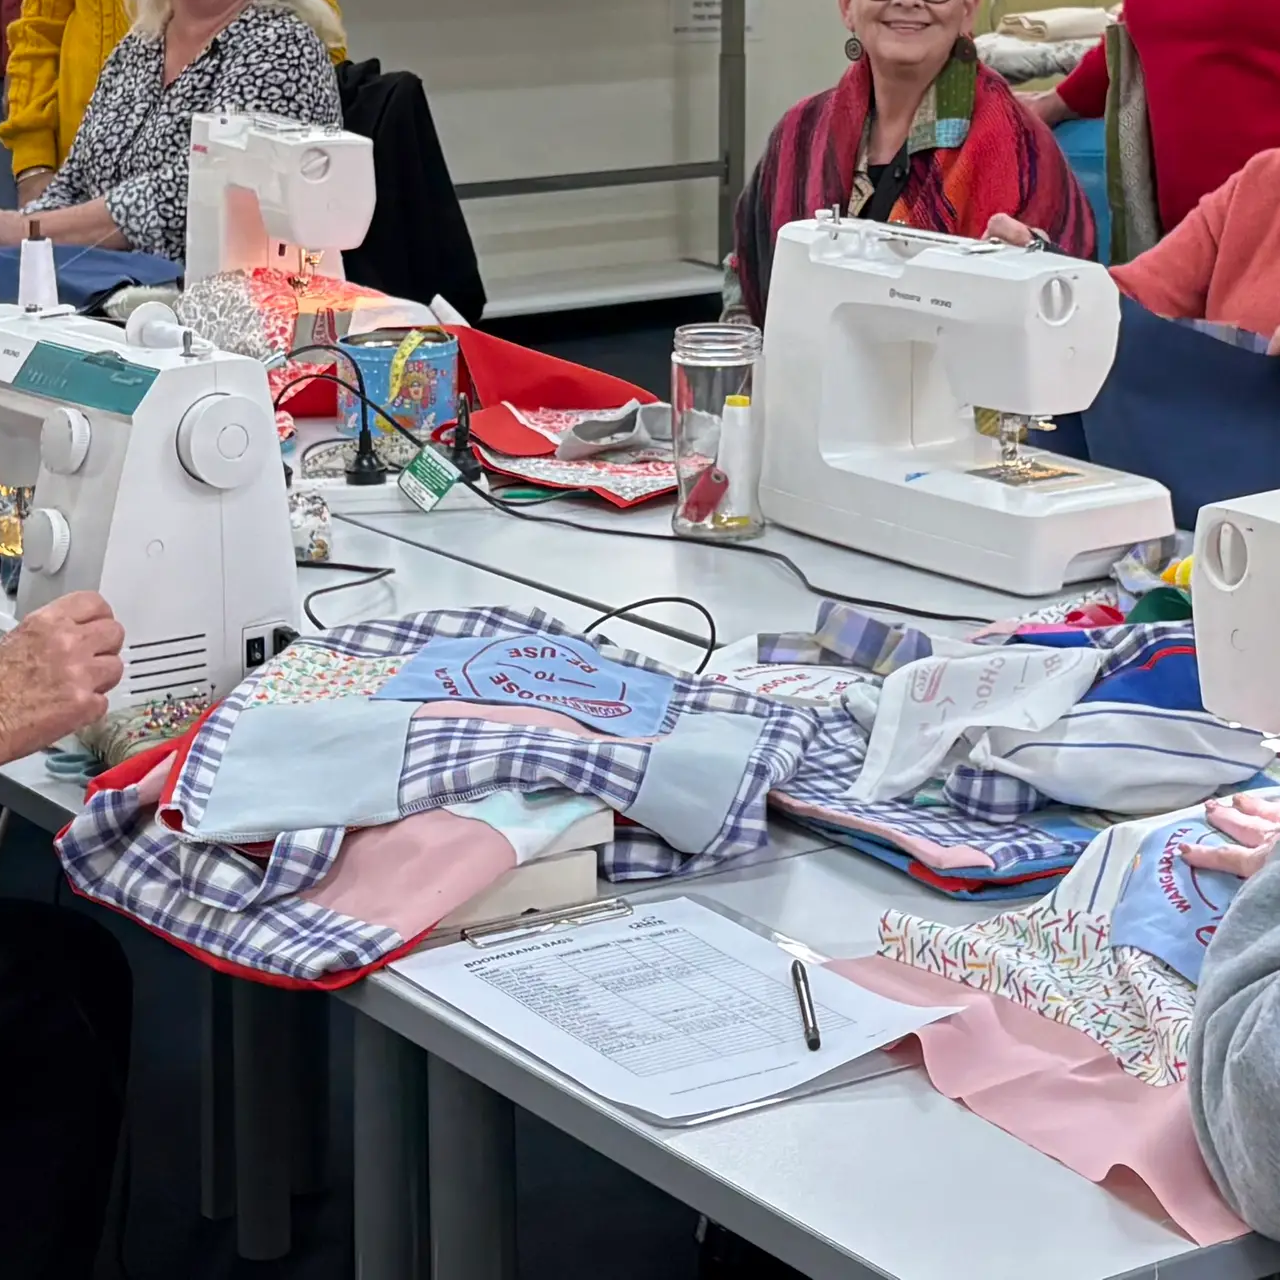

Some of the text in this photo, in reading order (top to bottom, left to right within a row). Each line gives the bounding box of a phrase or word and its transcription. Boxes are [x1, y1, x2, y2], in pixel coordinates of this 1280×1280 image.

[534, 670, 555, 683] TO
[464, 937, 574, 968] BOOMERANG BAGS
